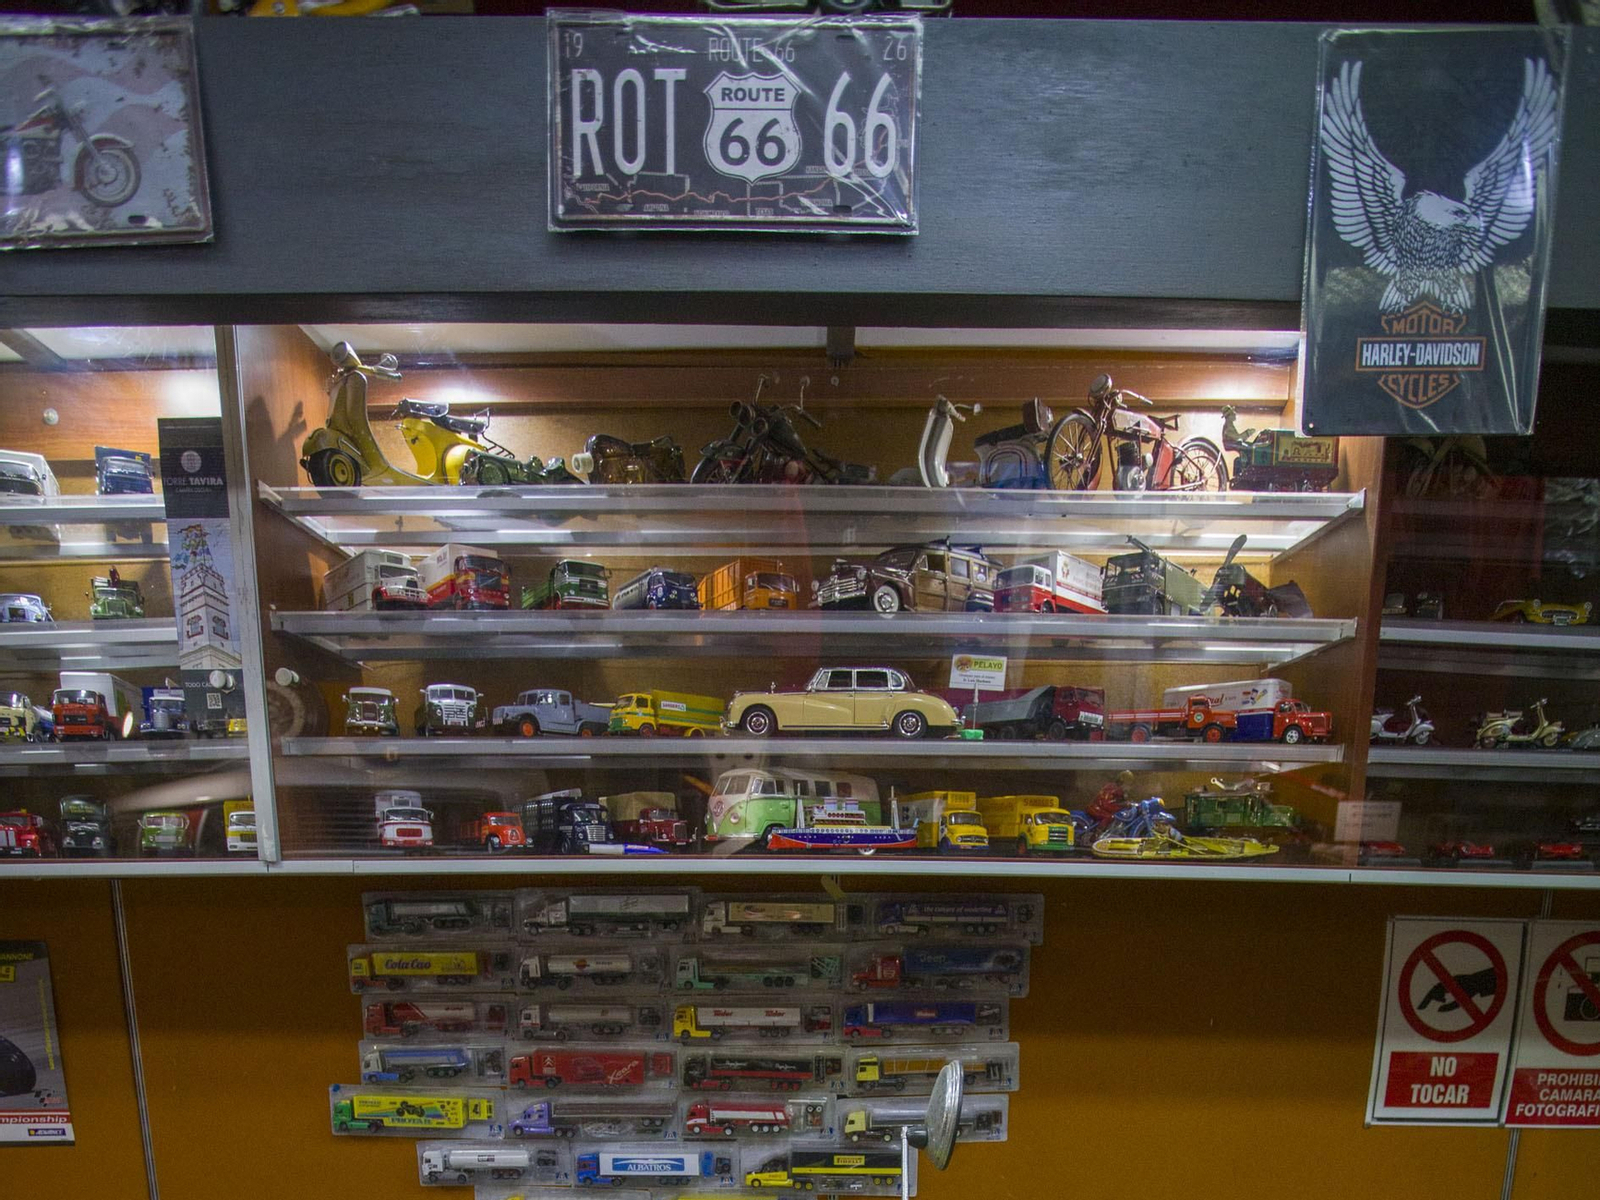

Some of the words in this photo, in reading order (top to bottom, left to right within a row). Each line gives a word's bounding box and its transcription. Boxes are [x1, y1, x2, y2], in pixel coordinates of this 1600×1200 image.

[564, 33, 584, 58] 19
[708, 37, 763, 62] ROUTE
[774, 37, 796, 63] 66
[883, 37, 907, 61] 26
[721, 87, 786, 103] ROUTE
[571, 68, 687, 176] ROT
[824, 71, 897, 178] 66
[720, 118, 785, 166] 66
[1393, 307, 1455, 334] MOTOR
[1361, 341, 1480, 367] HARLEY-DAVIDSON
[1387, 374, 1451, 402] CYCLES
[189, 477, 224, 486] TAVIRA
[973, 660, 1003, 670] PELAYO
[1430, 1056, 1457, 1077] NO
[1537, 1073, 1600, 1086] PROHIBI
[1411, 1084, 1470, 1104] TOCAR
[627, 1163, 672, 1172] ALBATROS
